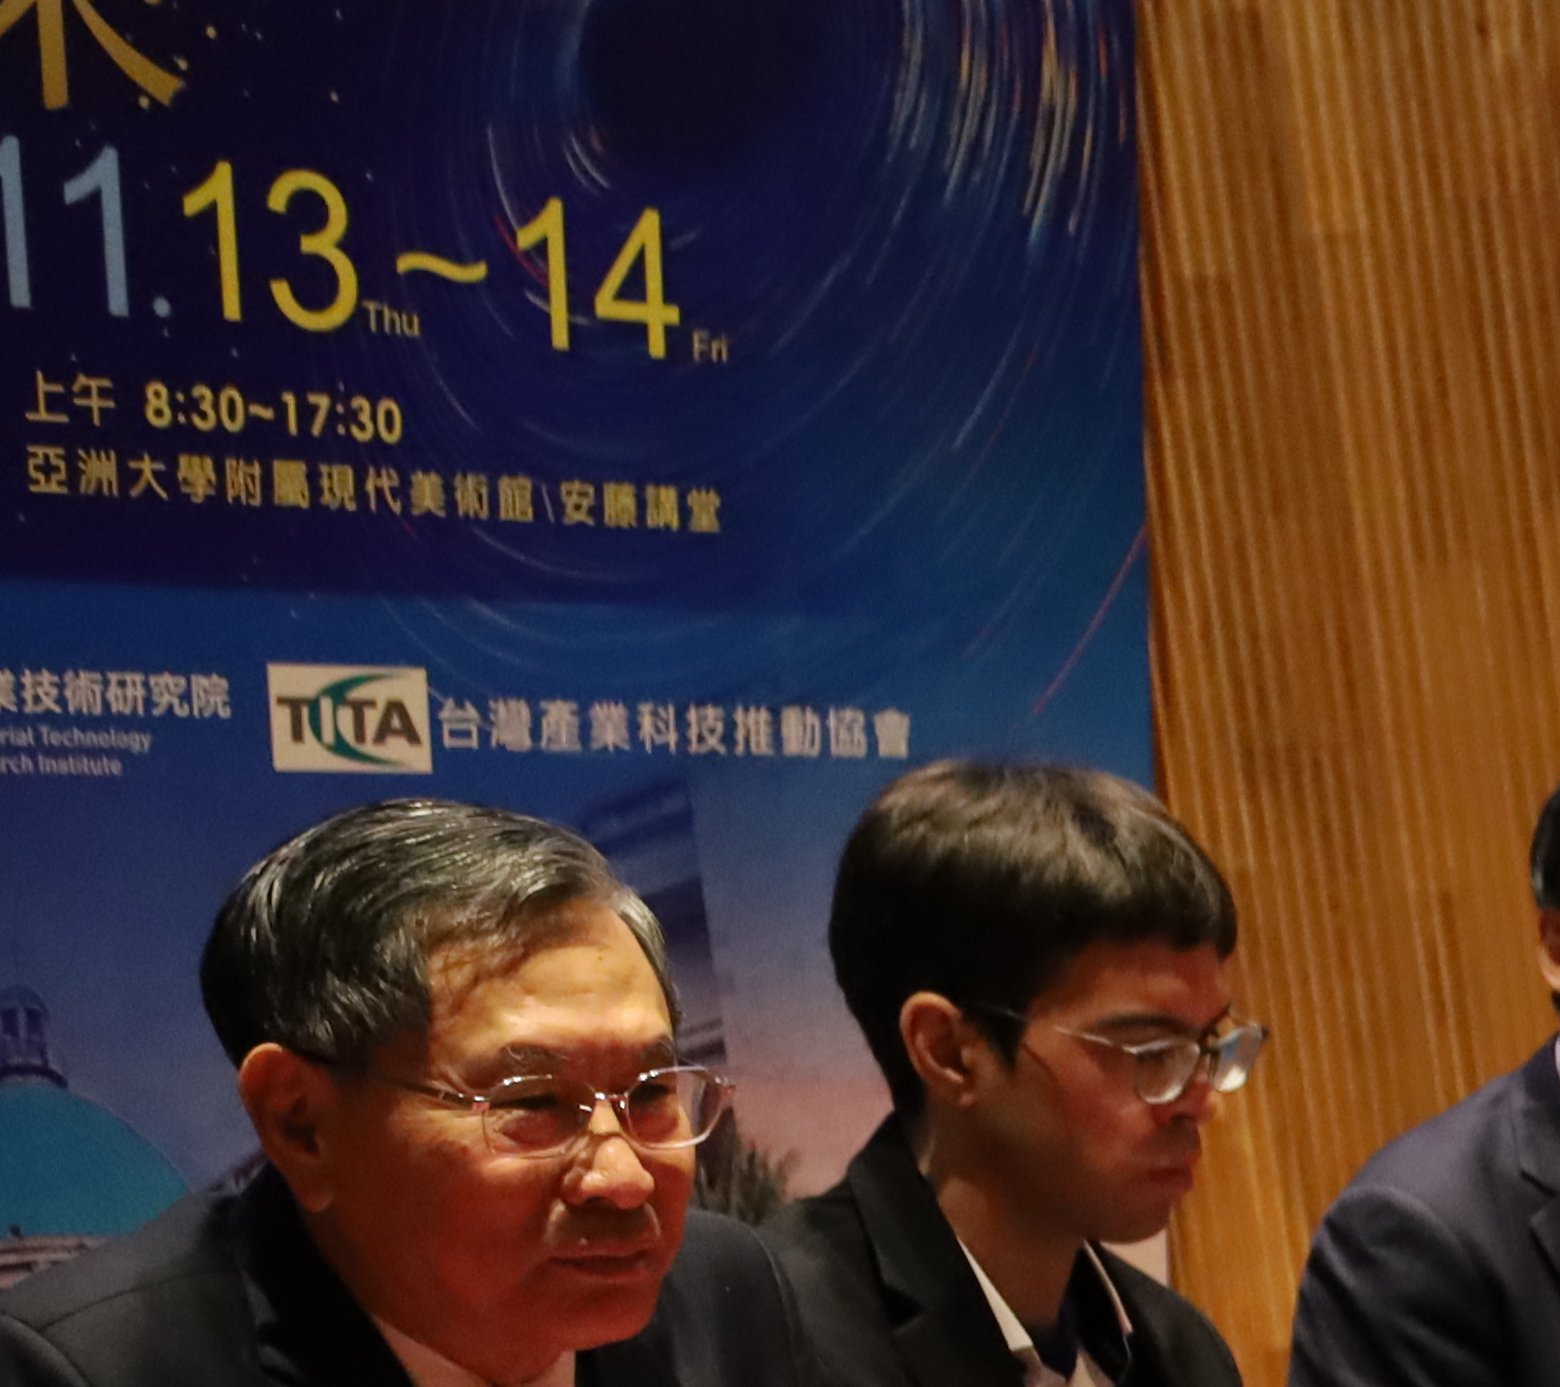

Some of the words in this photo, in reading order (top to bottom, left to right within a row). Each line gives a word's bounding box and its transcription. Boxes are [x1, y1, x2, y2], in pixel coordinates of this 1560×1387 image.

[362, 300, 420, 338] Thu
[692, 329, 729, 364] Fri
[25, 370, 116, 426] 上午
[144, 381, 402, 444] 8:30~17:30
[40, 726, 153, 754] Technology
[275, 695, 423, 748] TITA
[438, 698, 911, 759] 台灣產業科技推動協會
[39, 753, 123, 776] Institute
